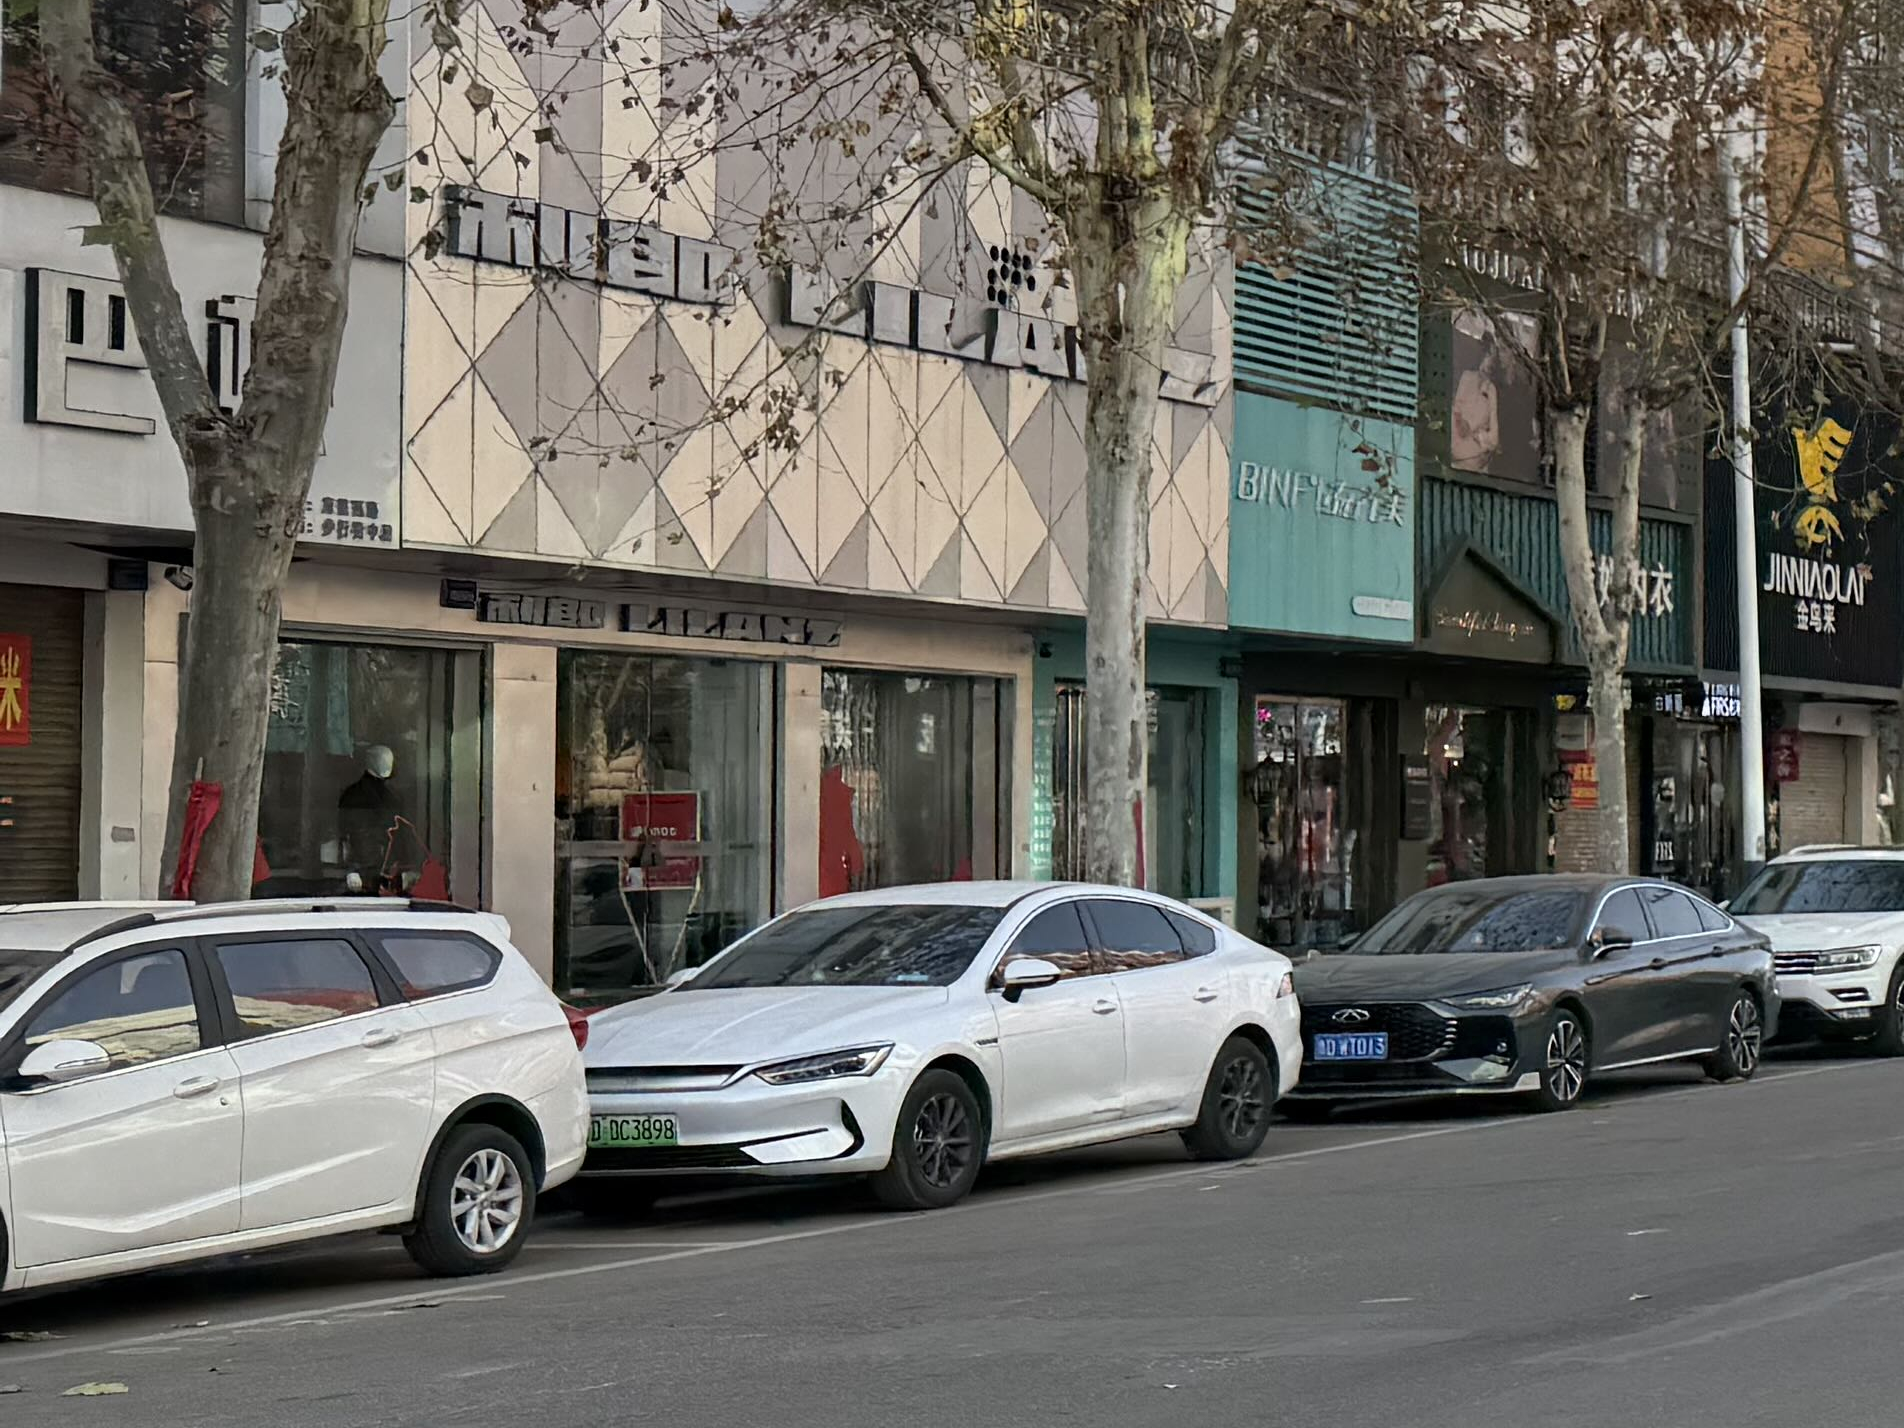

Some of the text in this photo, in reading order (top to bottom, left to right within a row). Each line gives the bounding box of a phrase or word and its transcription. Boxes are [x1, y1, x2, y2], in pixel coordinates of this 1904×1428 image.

[617, 602, 844, 647] LILANZ
[1796, 598, 1837, 635] 金鸟来
